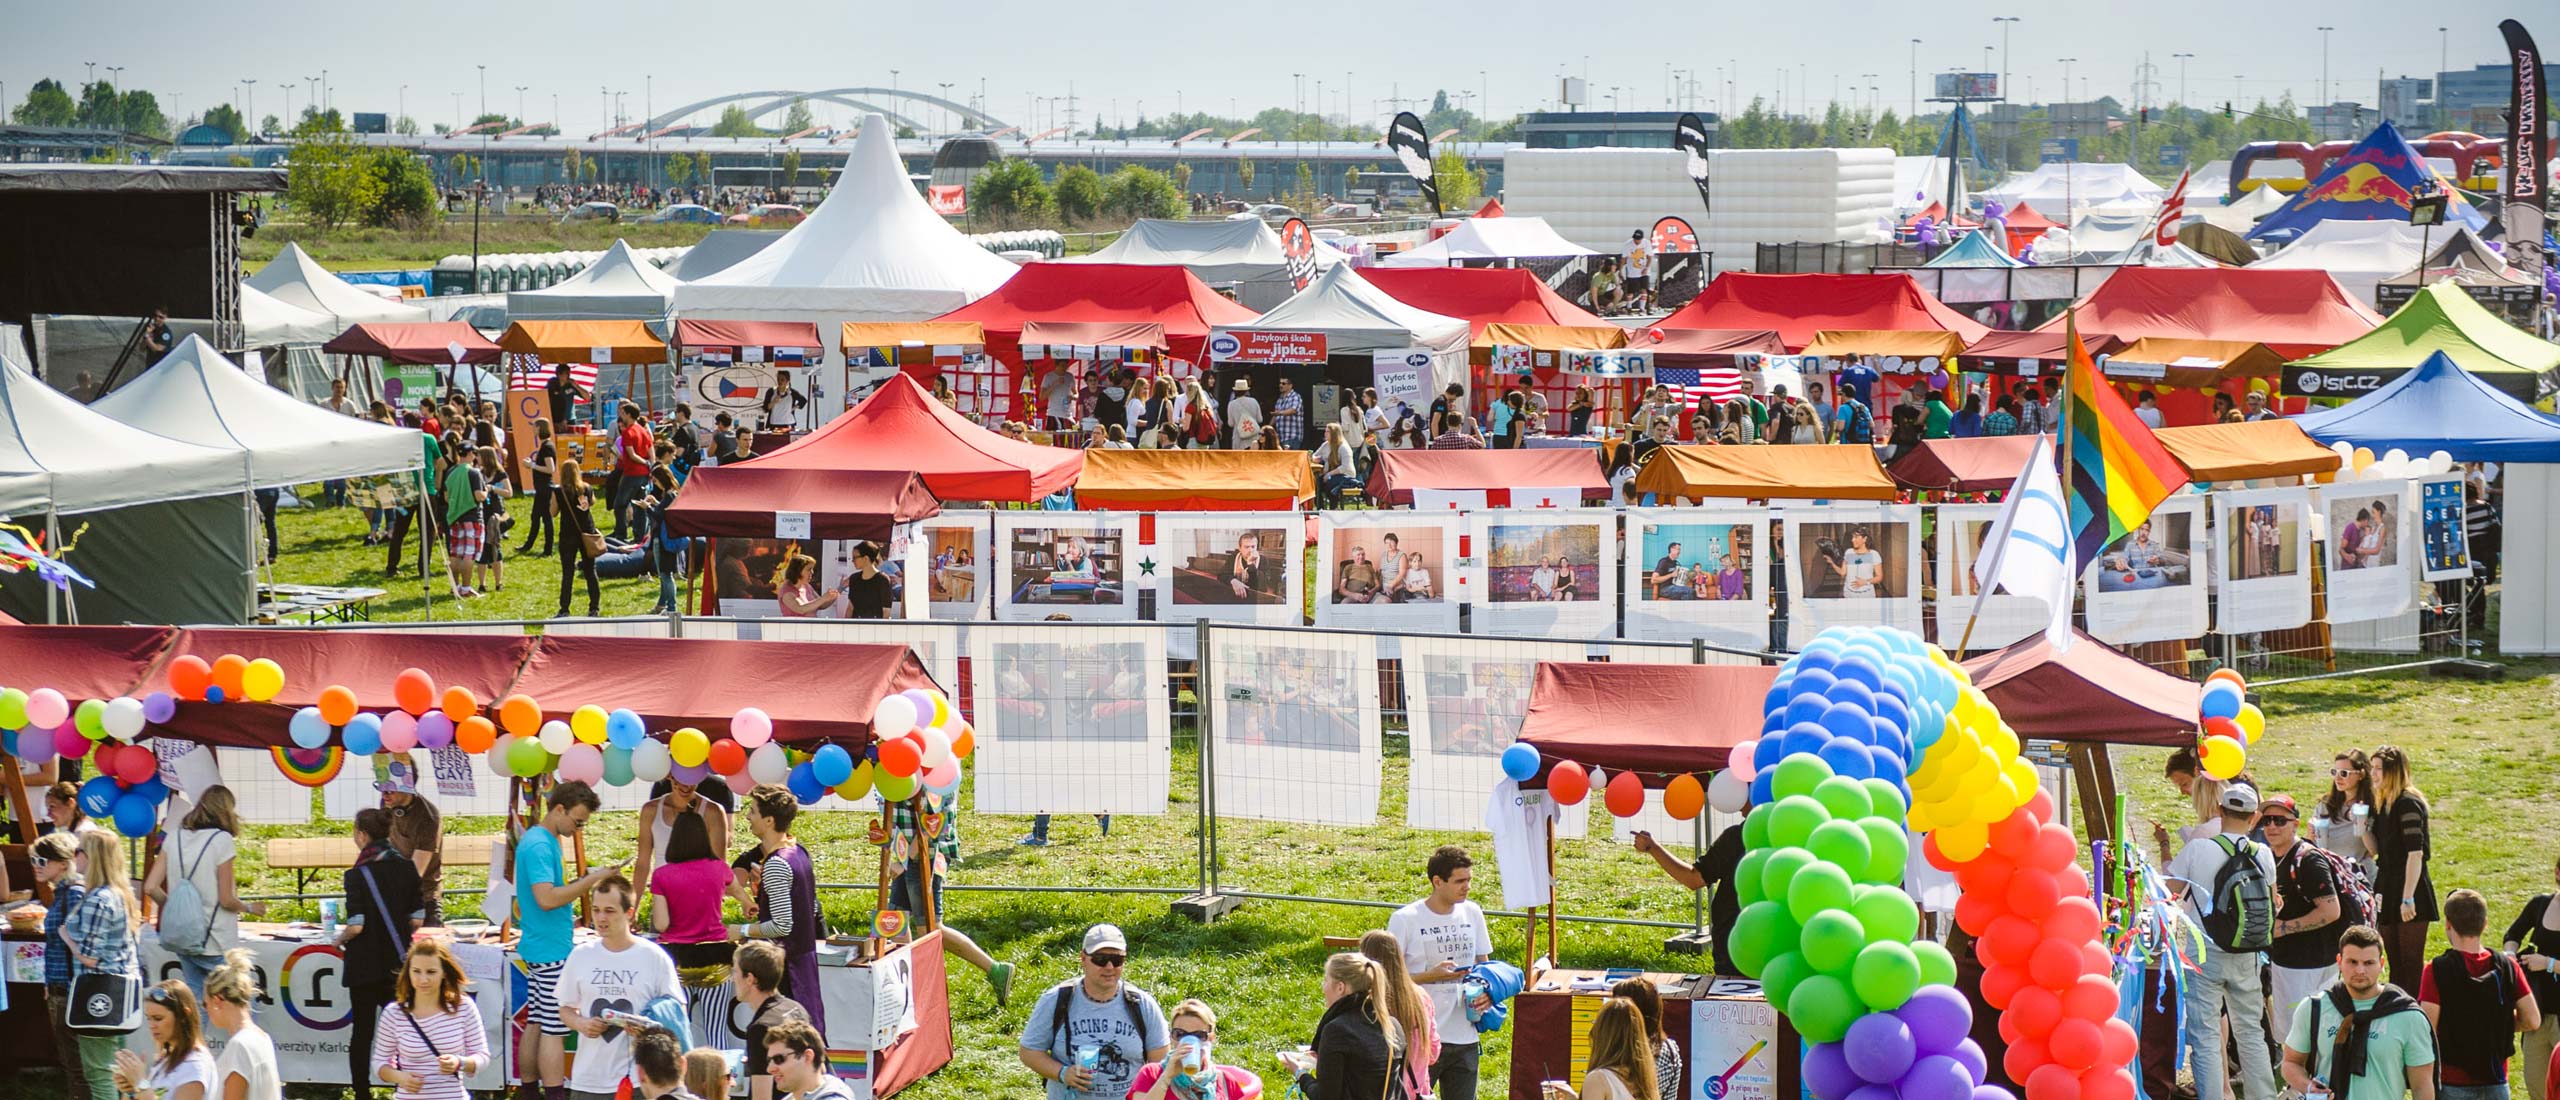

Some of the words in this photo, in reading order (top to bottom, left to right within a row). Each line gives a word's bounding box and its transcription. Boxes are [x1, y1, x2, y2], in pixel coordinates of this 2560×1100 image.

[1252, 333, 1289, 343] Jazyková
[1290, 334, 1312, 343] škola
[1247, 343, 1318, 357] www.jipka.cz
[400, 364, 433, 375] STAGE
[407, 384, 433, 395] NOVÉ
[1390, 384, 1417, 395] Jipkou
[590, 968, 639, 985] ŽENY
[1719, 1003, 1772, 1027] GALIBI
[1072, 1018, 1108, 1036] ACING
[319, 1041, 350, 1053] Karlo
